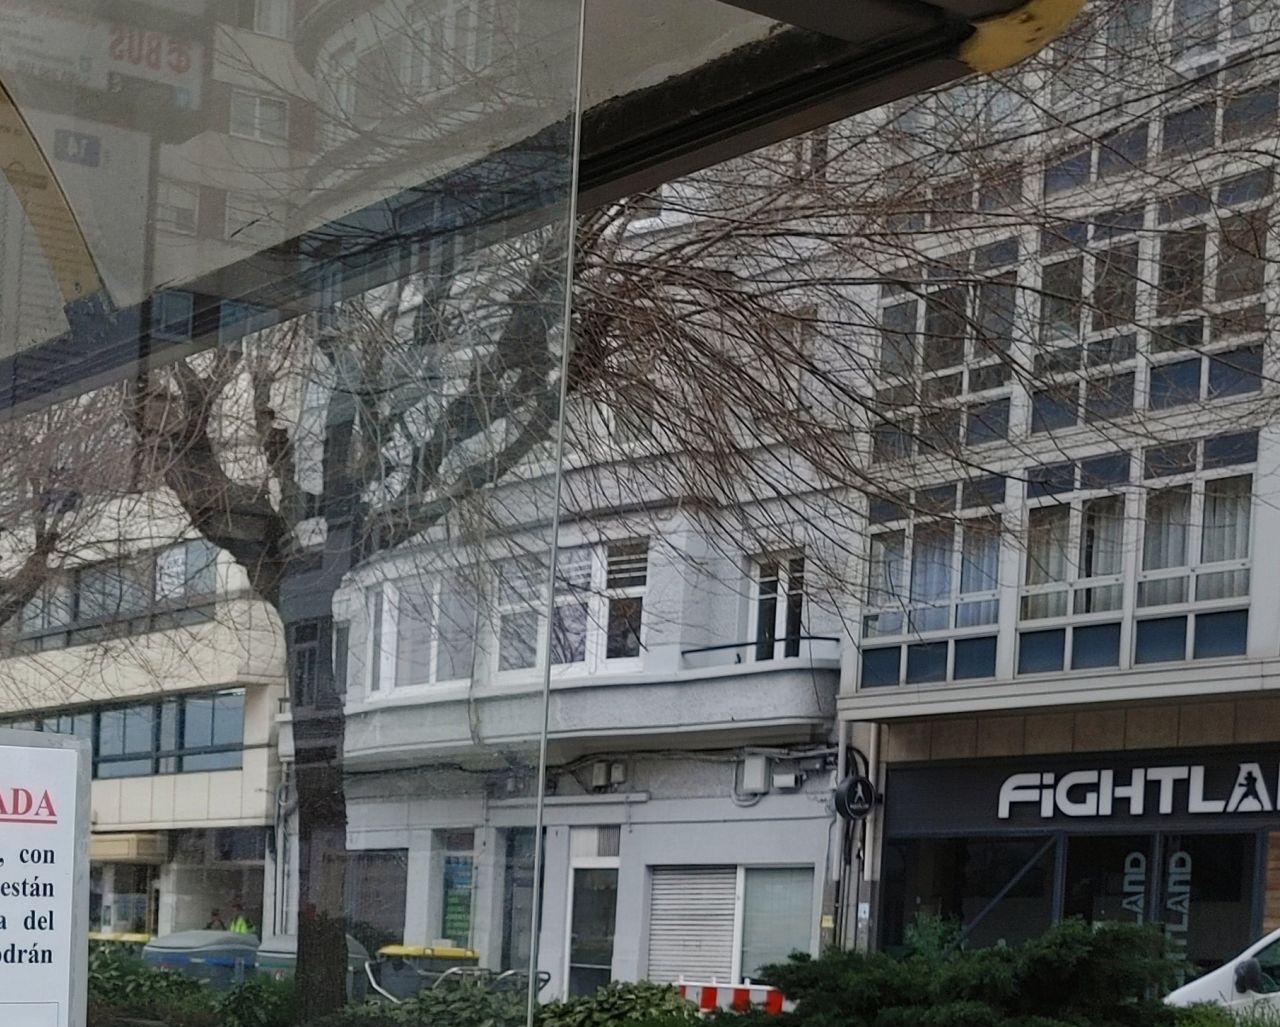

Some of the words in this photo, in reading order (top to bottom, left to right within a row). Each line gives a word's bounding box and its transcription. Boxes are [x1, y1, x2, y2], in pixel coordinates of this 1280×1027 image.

[19, 848, 56, 866] con
[1, 876, 54, 897] están
[24, 910, 54, 930] del
